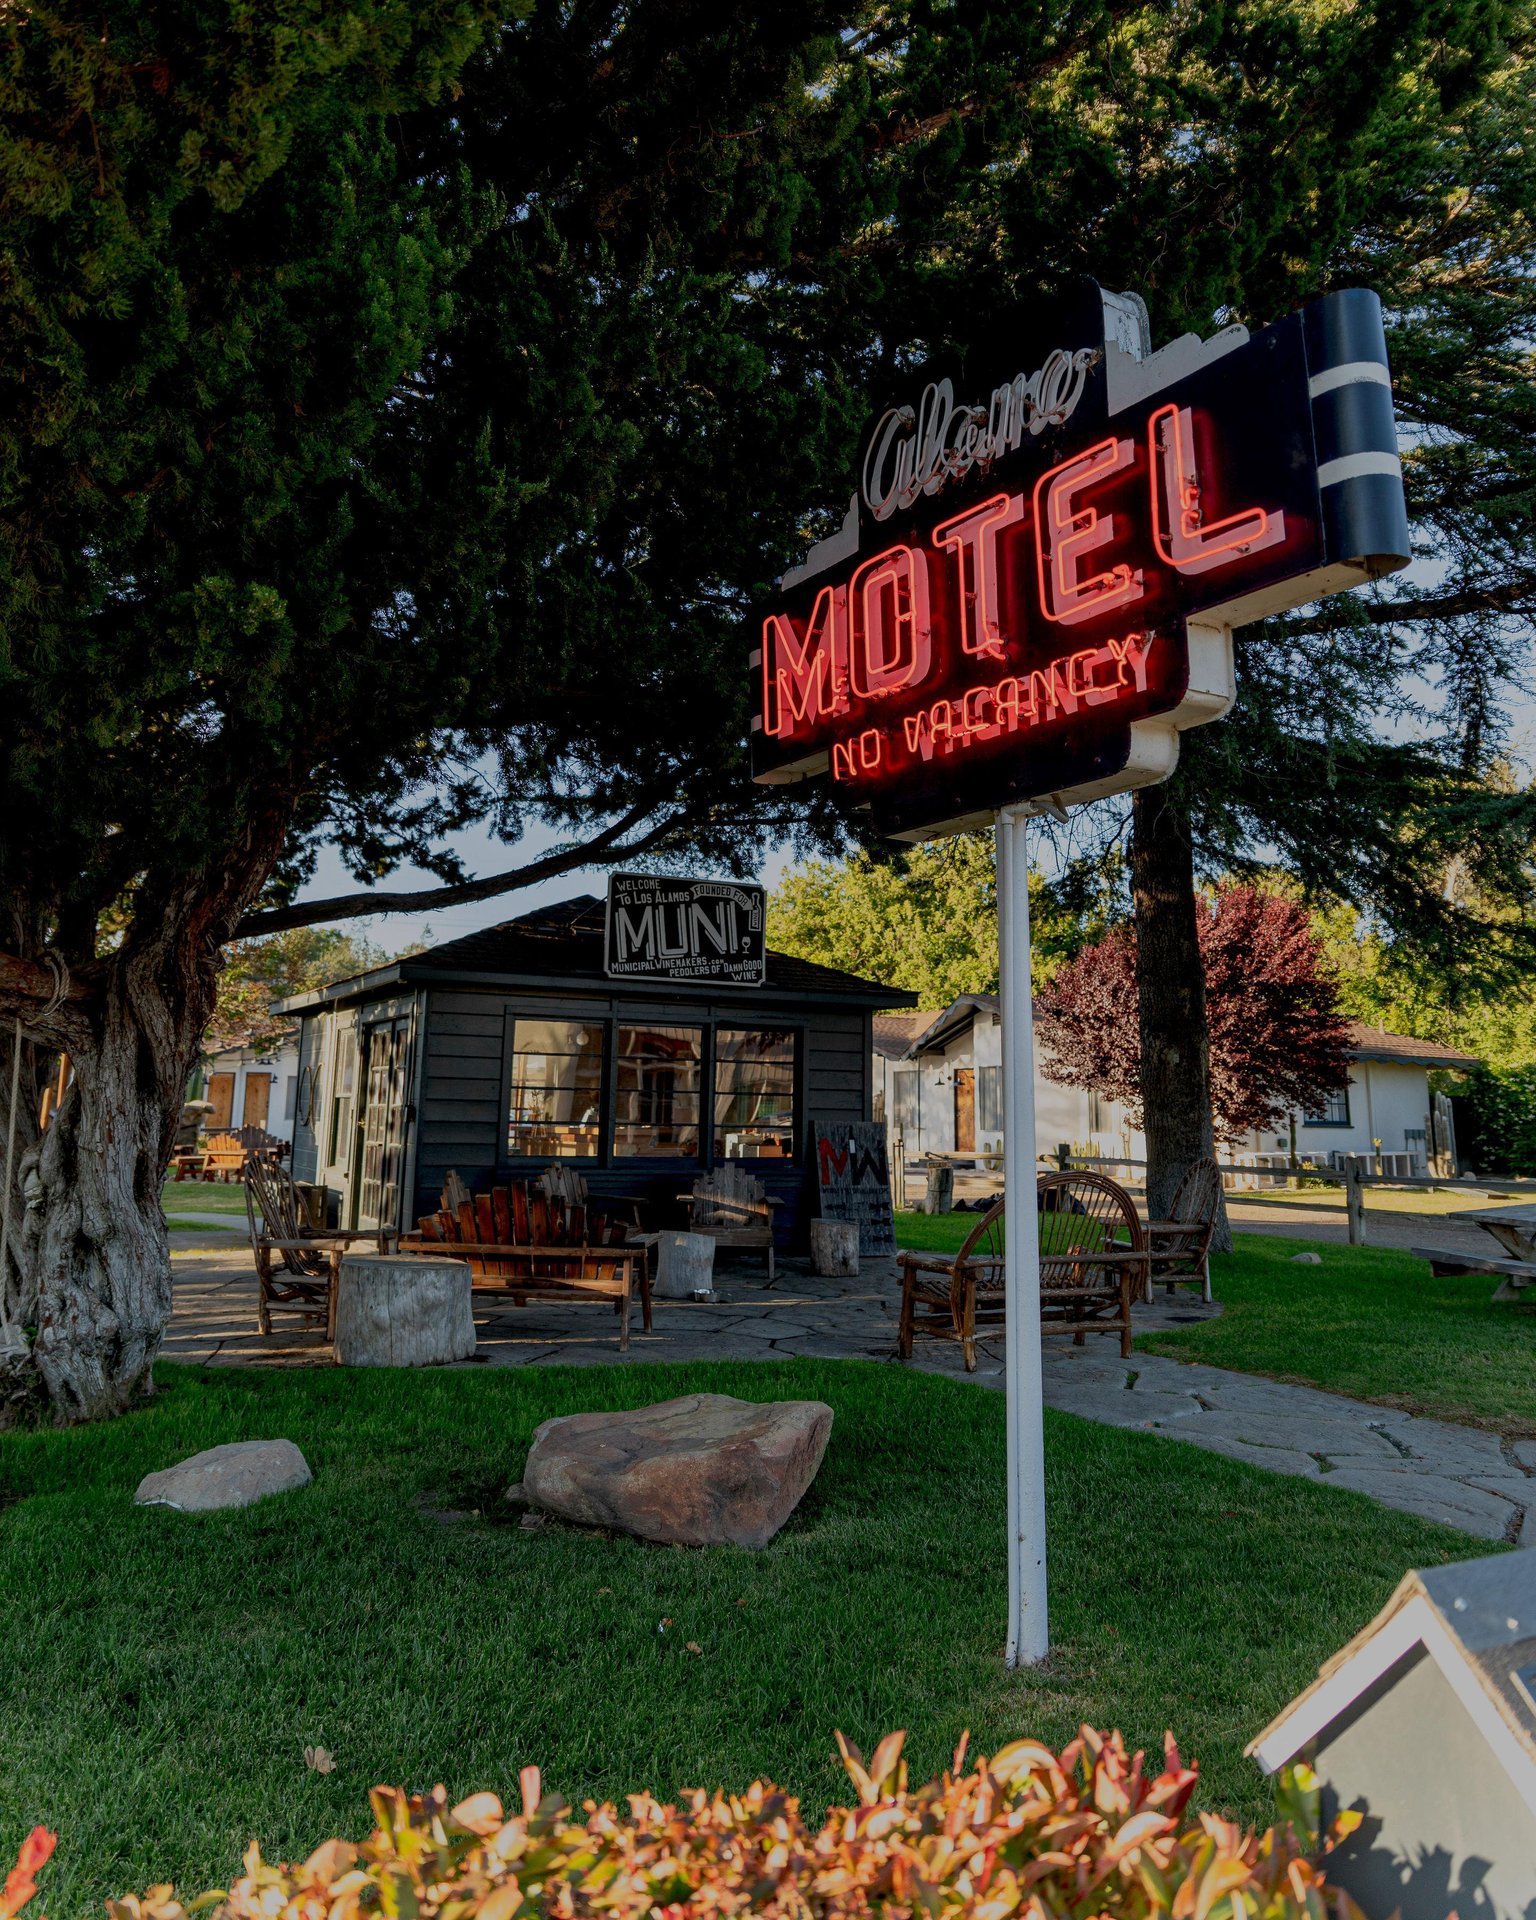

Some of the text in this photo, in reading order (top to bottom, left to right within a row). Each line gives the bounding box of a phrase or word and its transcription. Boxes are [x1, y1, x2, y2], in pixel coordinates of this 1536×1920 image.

[763, 403, 1285, 739] MOTEL
[833, 630, 1155, 781] NO VACANCY
[616, 879, 661, 891] WELCOME
[694, 886, 748, 906] FOUNDED FOR
[615, 901, 738, 962] MUNI
[669, 967, 710, 977] PEDDLERS
[711, 965, 722, 974] OF
[731, 971, 757, 981] WINE
